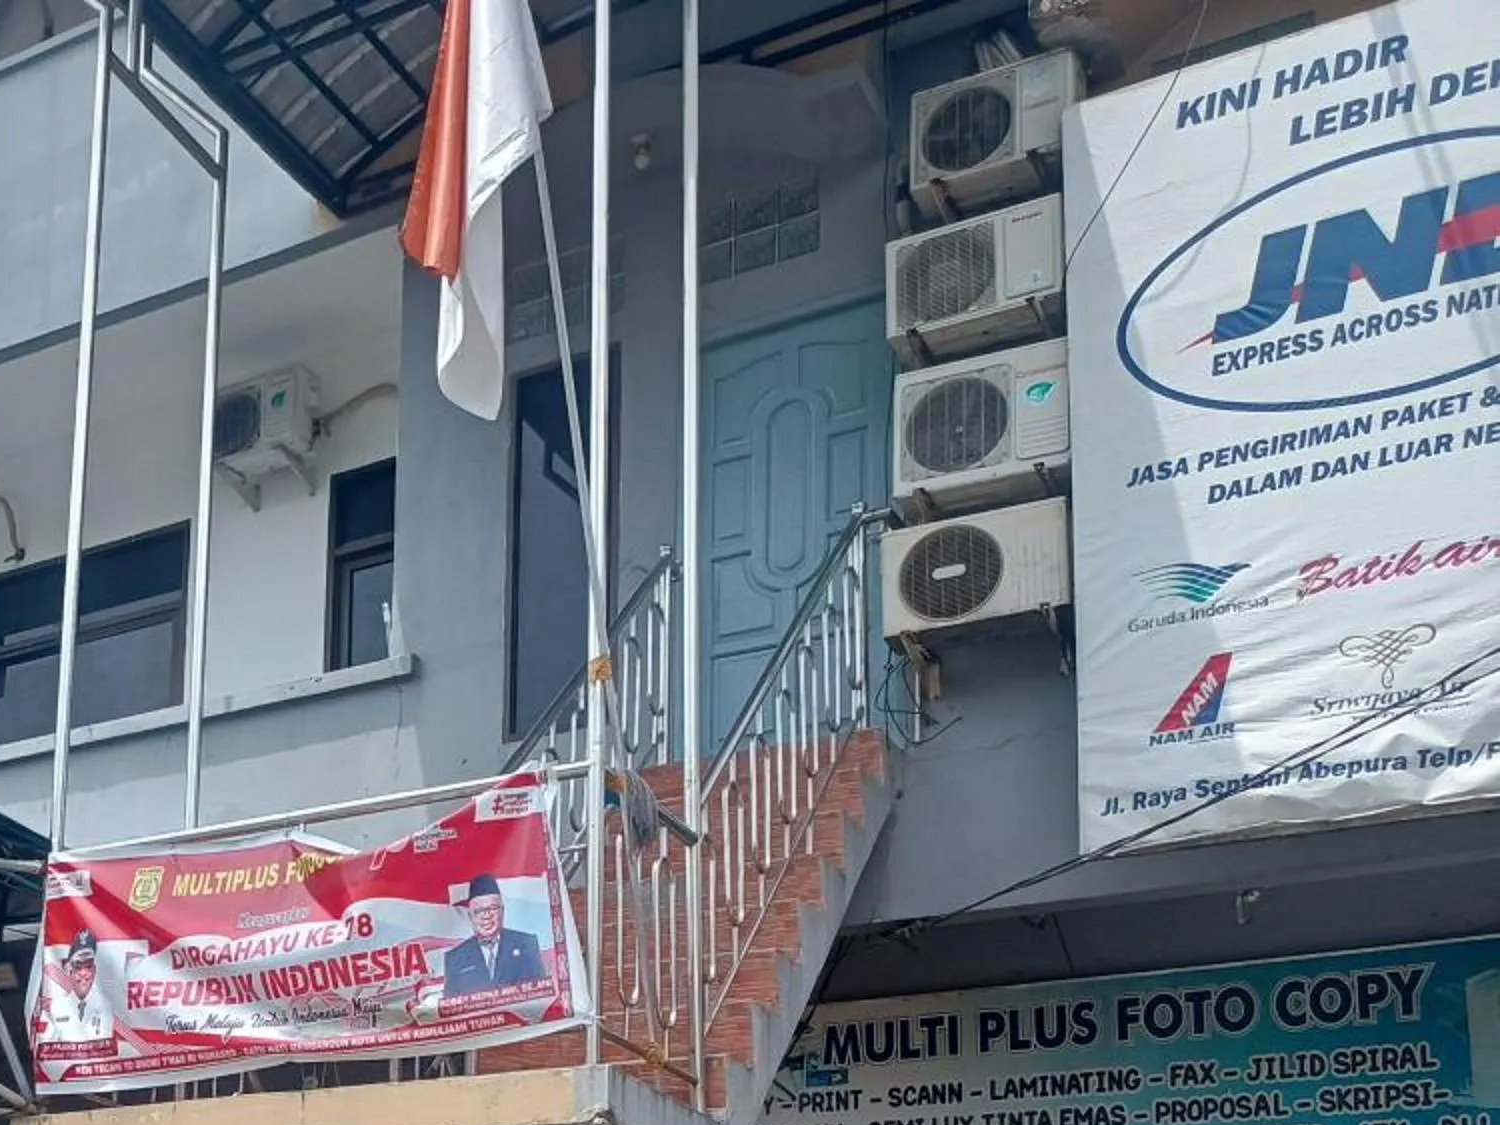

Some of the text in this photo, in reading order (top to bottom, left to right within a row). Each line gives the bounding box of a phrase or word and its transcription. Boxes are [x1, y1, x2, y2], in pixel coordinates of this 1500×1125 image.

[1176, 34, 1409, 130] KINI HADIR
[1289, 83, 1415, 145] LEBIH
[1211, 330, 1325, 377] EXPRESS
[1330, 298, 1438, 348] ACROSS
[1127, 455, 1189, 488] JASA
[1197, 414, 1373, 472] PENGIRIMAN
[1380, 392, 1472, 430] PAKET
[1207, 466, 1302, 504] DALAM
[1310, 452, 1370, 482] DAN
[1378, 433, 1454, 467] LUAR
[1296, 539, 1427, 599] Batik
[1127, 596, 1269, 633] Garuda Indonesia
[1180, 671, 1219, 727] NAM
[1149, 722, 1235, 747] NAM AIR
[1100, 797, 1126, 817] Jl.
[1133, 787, 1187, 814] Raya
[1298, 755, 1407, 783] Abepura
[172, 865, 281, 896] MULTIPLUS
[170, 932, 299, 970] DIRGAHAYU
[303, 913, 374, 950] KE-78
[127, 943, 428, 1010] REPUBLIK INDONESIA
[165, 1013, 197, 1034] Terus
[822, 962, 1434, 1068] MULTI PLUS FOTO COPY
[799, 1089, 862, 1113] PRINT
[887, 1082, 963, 1108] SCANN
[989, 1068, 1141, 1101] LAMINATING
[1169, 1062, 1216, 1088] FAX
[1247, 1051, 1326, 1081] JILID
[1332, 1044, 1438, 1076] SPIRAL
[1155, 1093, 1288, 1125] PROPOSAL
